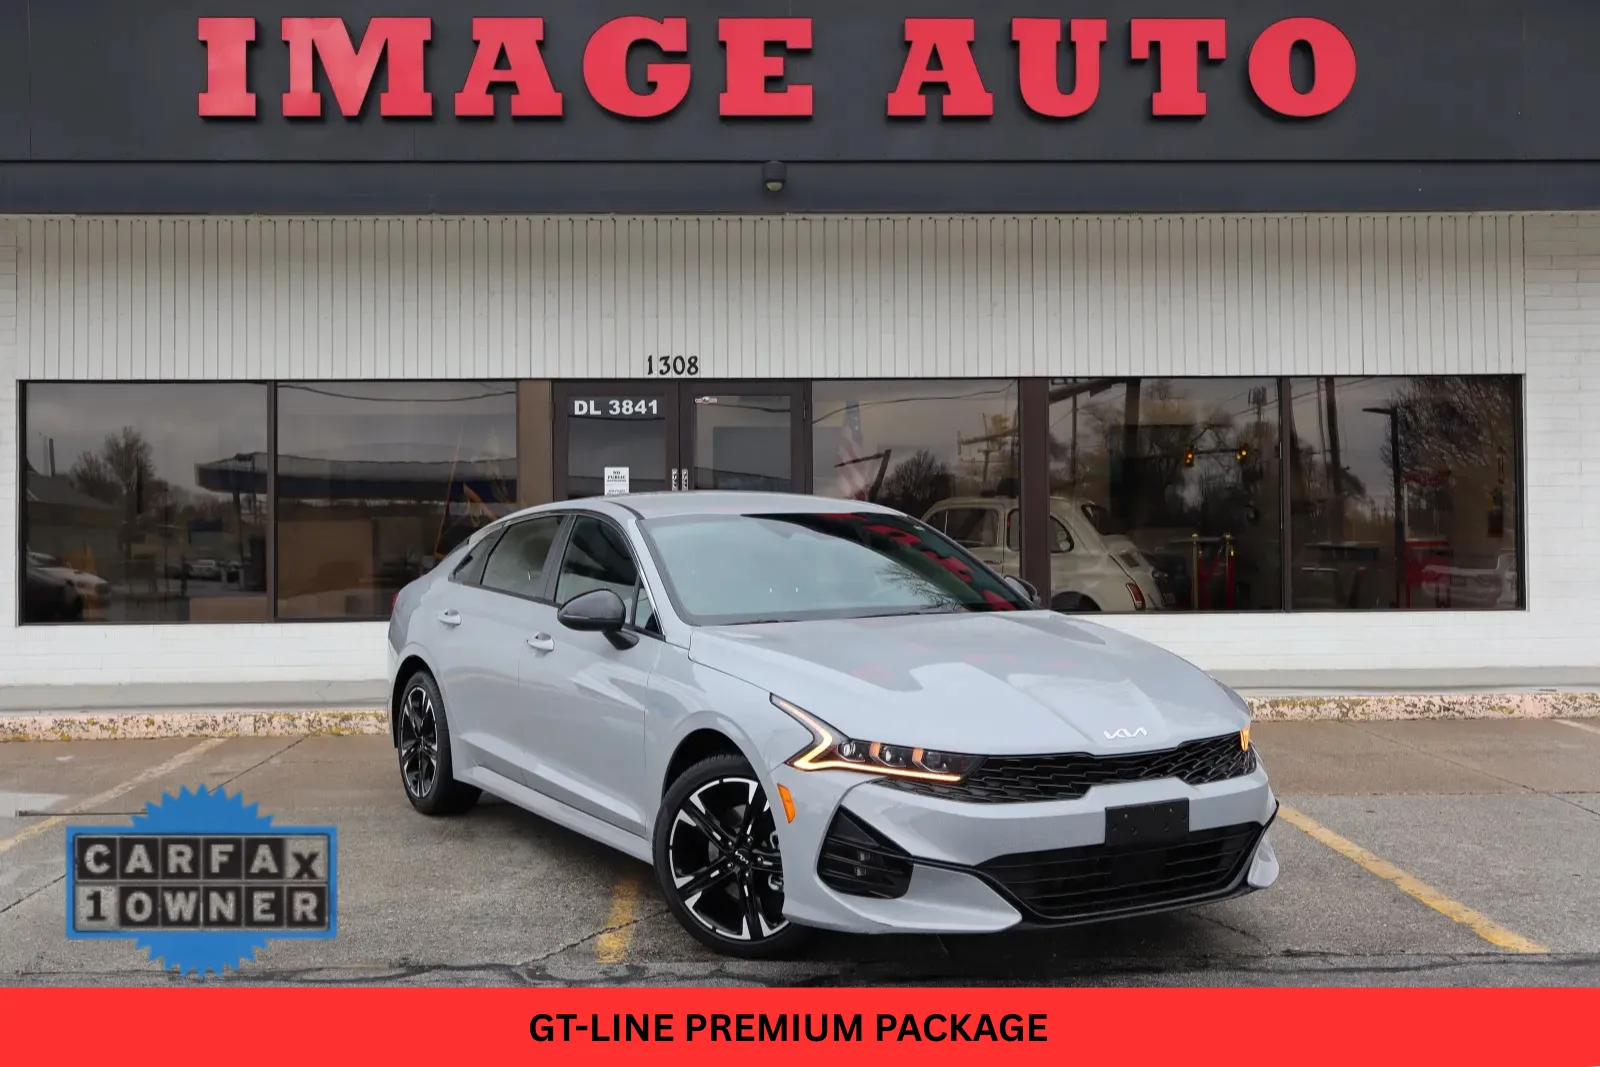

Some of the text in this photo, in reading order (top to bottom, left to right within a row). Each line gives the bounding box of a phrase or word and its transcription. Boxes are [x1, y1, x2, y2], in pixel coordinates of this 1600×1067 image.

[198, 16, 1357, 117] IMAGE AUTO
[647, 355, 699, 376] 1308
[574, 400, 658, 415] DL 3841
[1103, 727, 1148, 739] KIA
